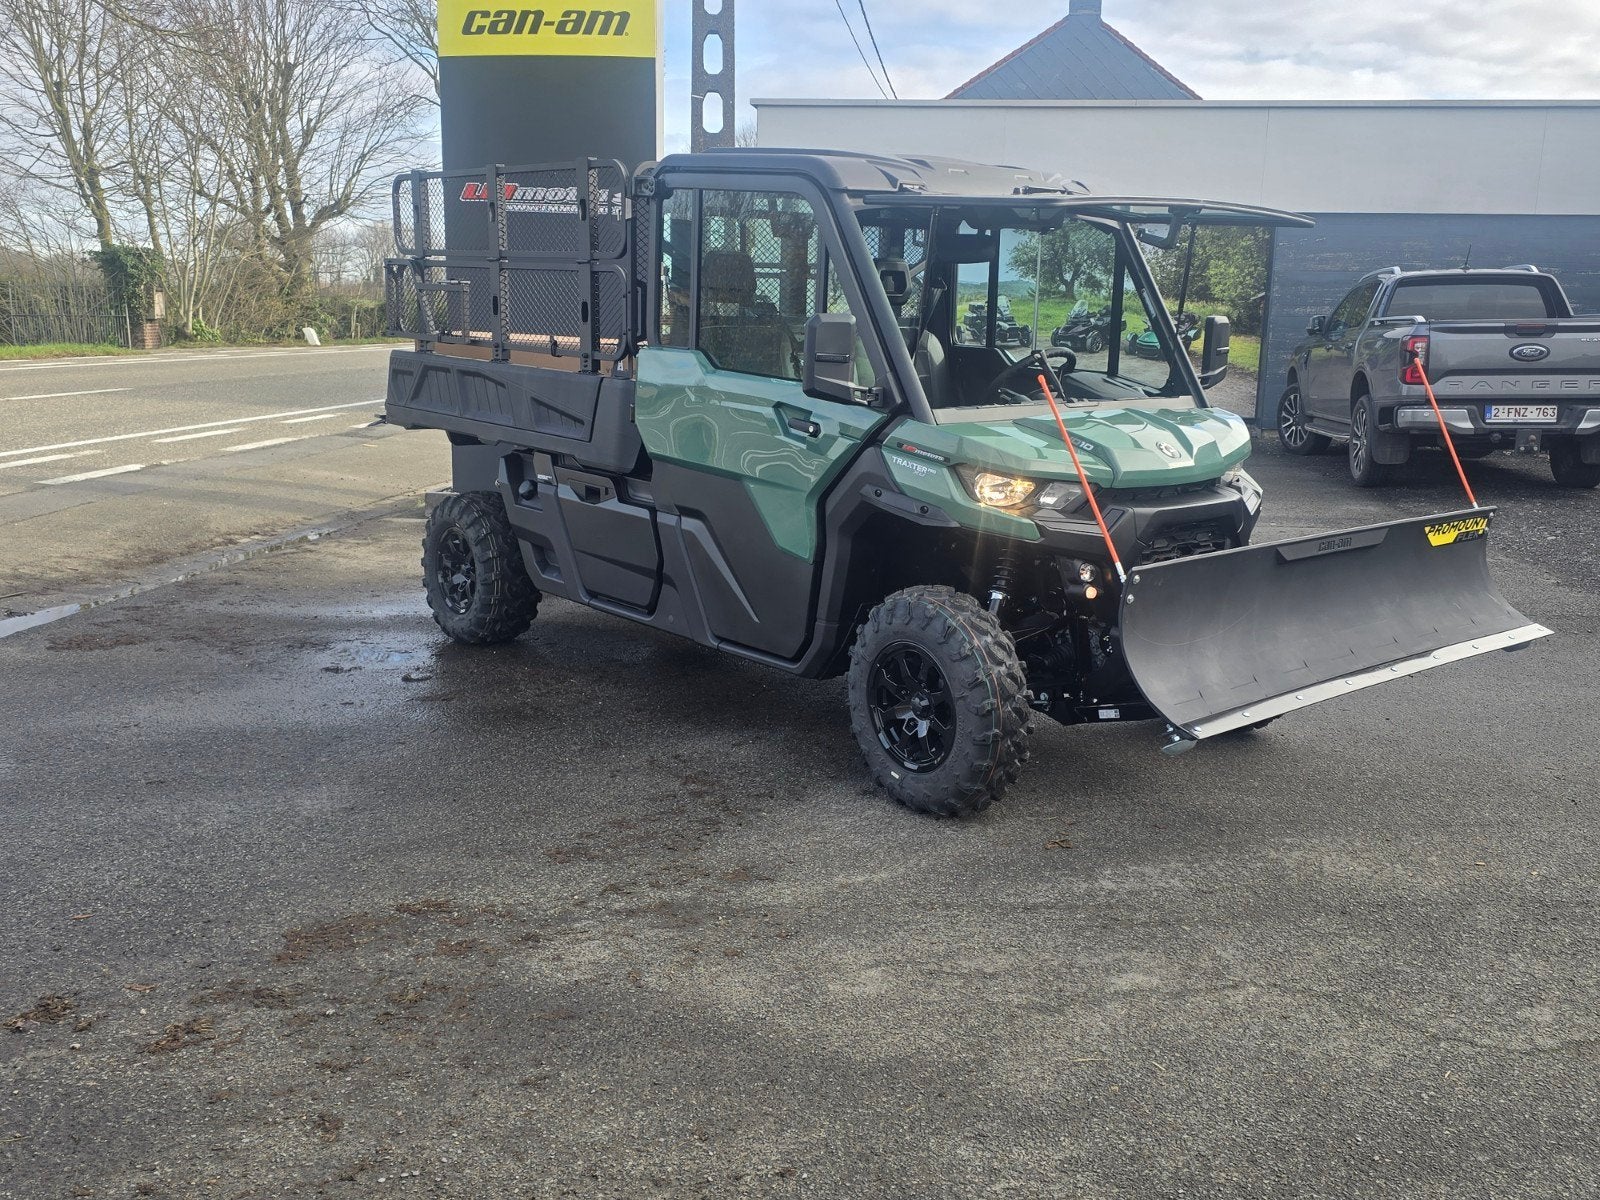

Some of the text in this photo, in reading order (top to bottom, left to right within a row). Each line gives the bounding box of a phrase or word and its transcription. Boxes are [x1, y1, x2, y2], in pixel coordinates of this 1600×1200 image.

[461, 9, 631, 36] can-am
[1493, 407, 1557, 418] 2-FNZ-763
[892, 455, 928, 474] TRAXTER
[1427, 517, 1487, 537] PROMOUNT
[1318, 536, 1352, 552] can-am
